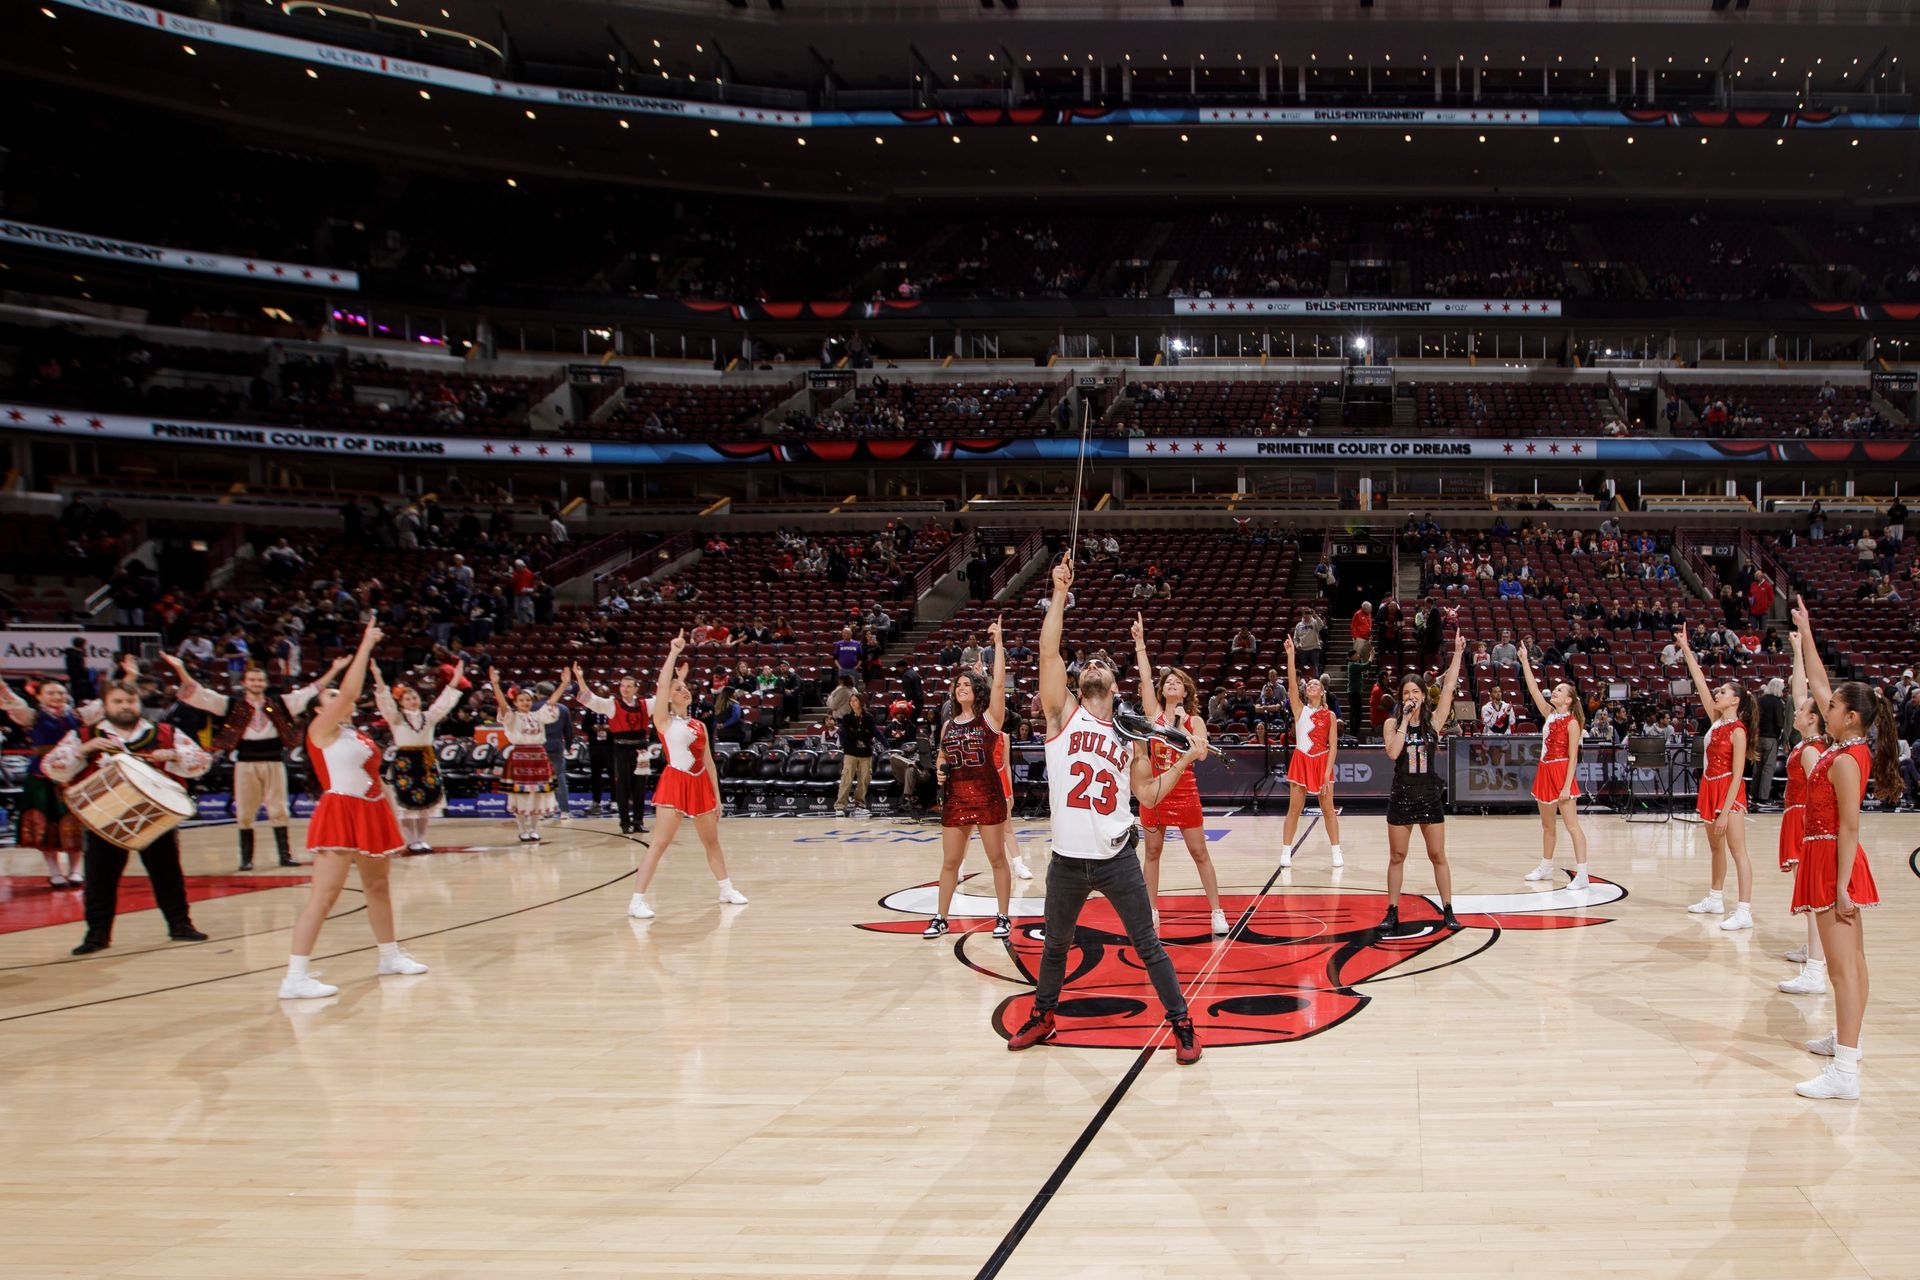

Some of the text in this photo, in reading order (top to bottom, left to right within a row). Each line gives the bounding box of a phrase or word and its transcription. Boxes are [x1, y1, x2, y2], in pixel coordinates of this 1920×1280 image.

[317, 48, 375, 68] ULTRA
[1345, 111, 1424, 120] ENTERTAINMENT
[1341, 302, 1432, 312] ENTERTAINMENT
[152, 423, 445, 455] PRIMETIME COURT OF DREAMS
[1257, 443, 1472, 455] PRIMETIME COURT OF DREAMS
[1715, 546, 1729, 555] 102
[4, 642, 113, 659] Advote
[486, 732, 499, 747] G
[441, 745, 459, 761] G
[472, 744, 490, 761] G
[943, 739, 985, 769] 55
[1068, 731, 1129, 772] BULLS
[1407, 745, 1427, 773] 11
[1067, 761, 1119, 815] 23
